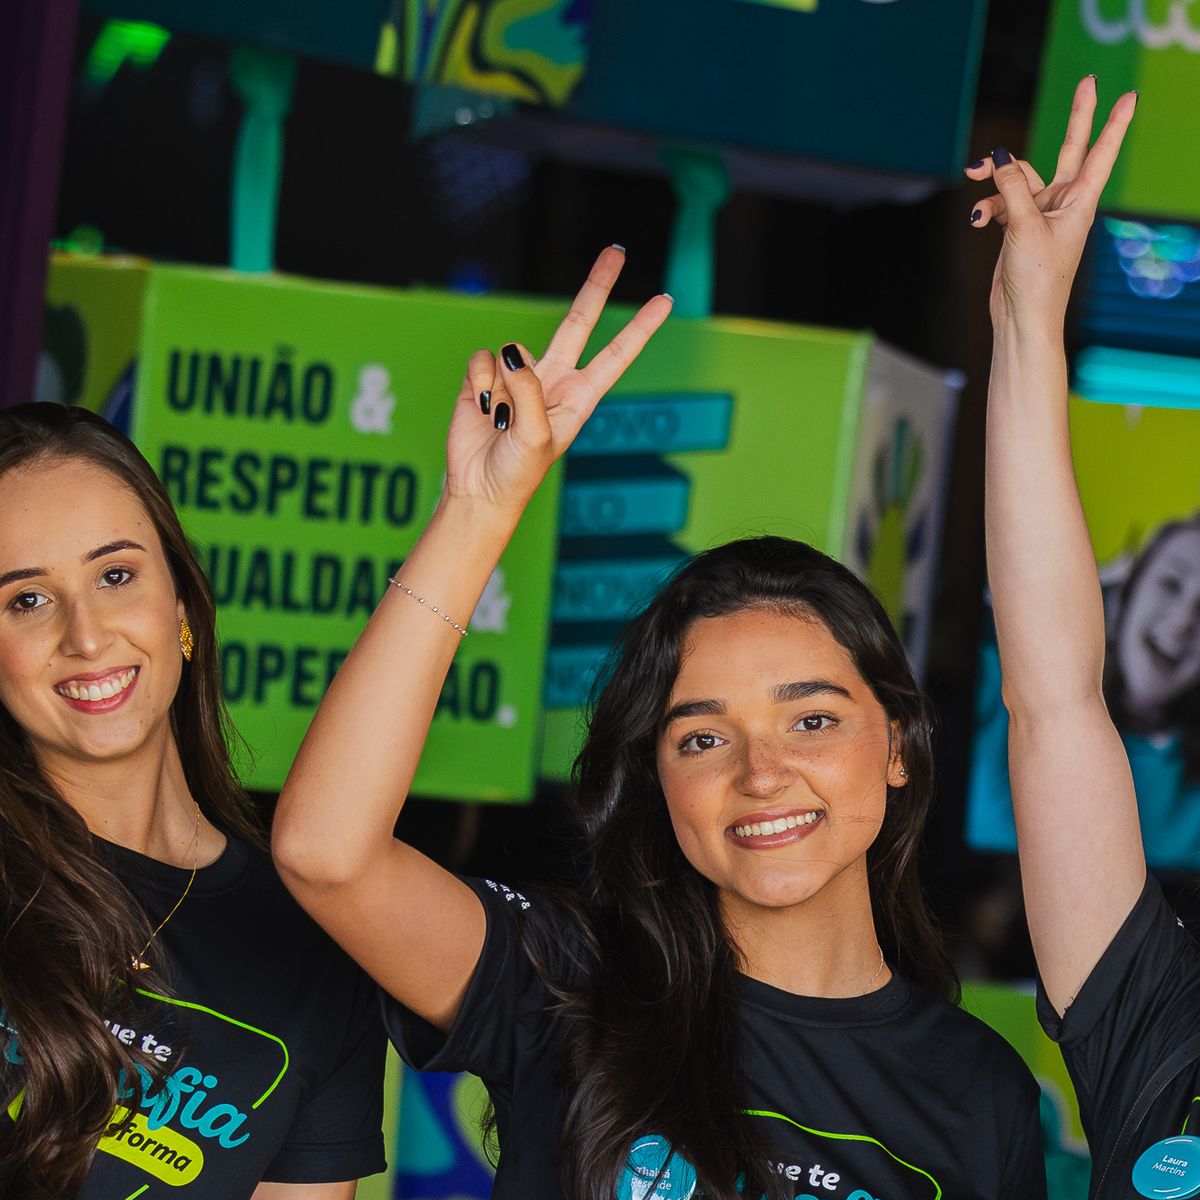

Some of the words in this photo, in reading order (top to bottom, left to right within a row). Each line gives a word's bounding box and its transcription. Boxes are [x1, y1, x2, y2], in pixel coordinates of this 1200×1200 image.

[167, 344, 334, 426] UNIÃO
[349, 363, 396, 435] &
[161, 444, 420, 528] RESPEITO
[141, 1033, 172, 1063] te
[1152, 1162, 1186, 1177] Martins
[1162, 1154, 1188, 1167] Laura
[808, 1163, 841, 1191] te
